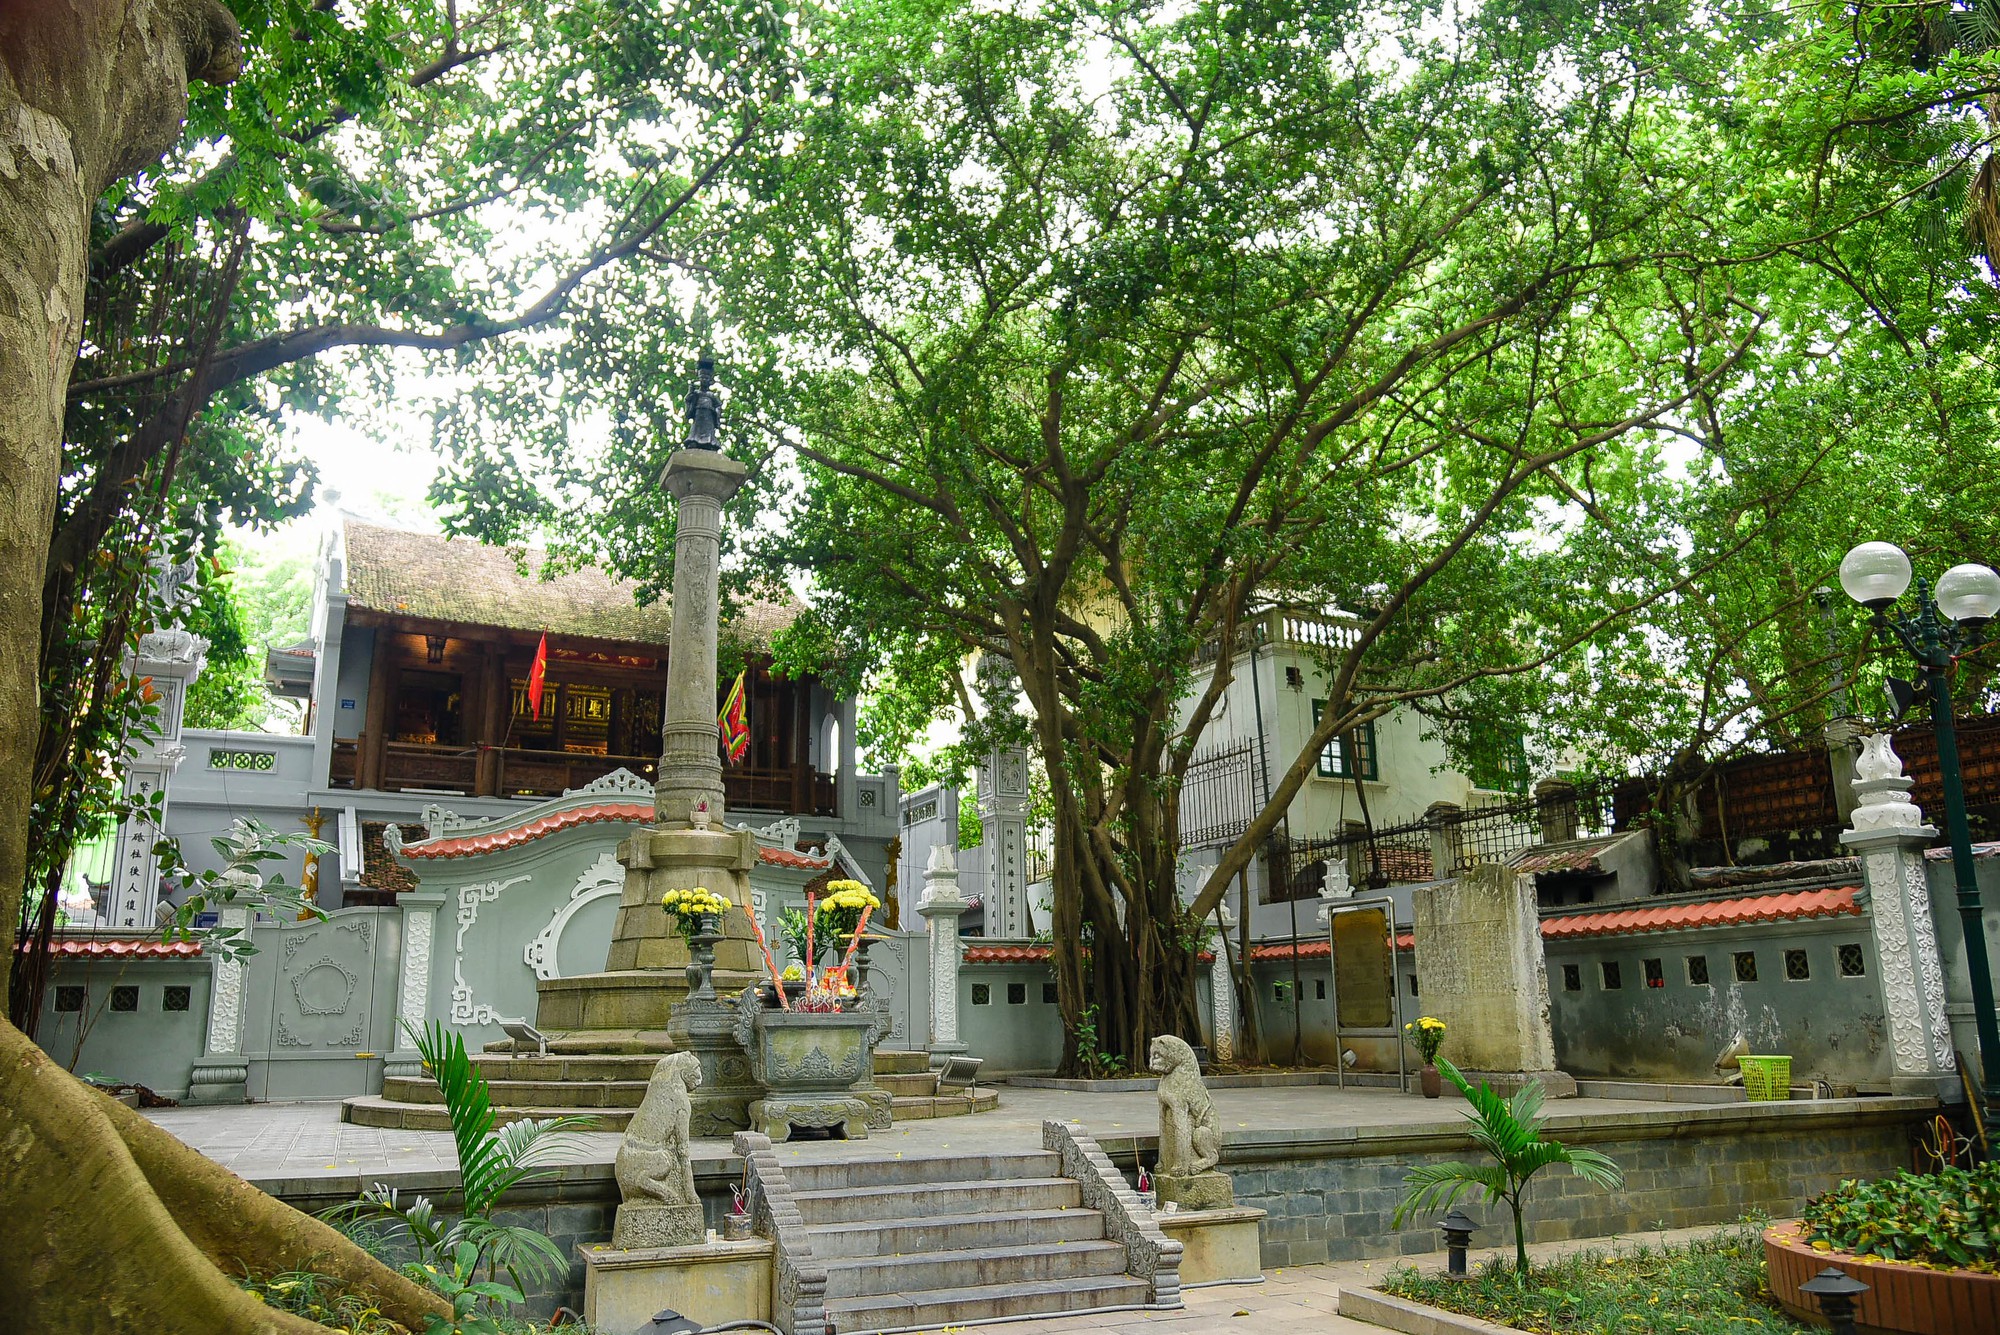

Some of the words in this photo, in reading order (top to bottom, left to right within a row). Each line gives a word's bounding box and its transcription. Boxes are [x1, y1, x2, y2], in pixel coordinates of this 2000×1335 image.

[124, 780, 151, 928] 擎砥柱後人復建
